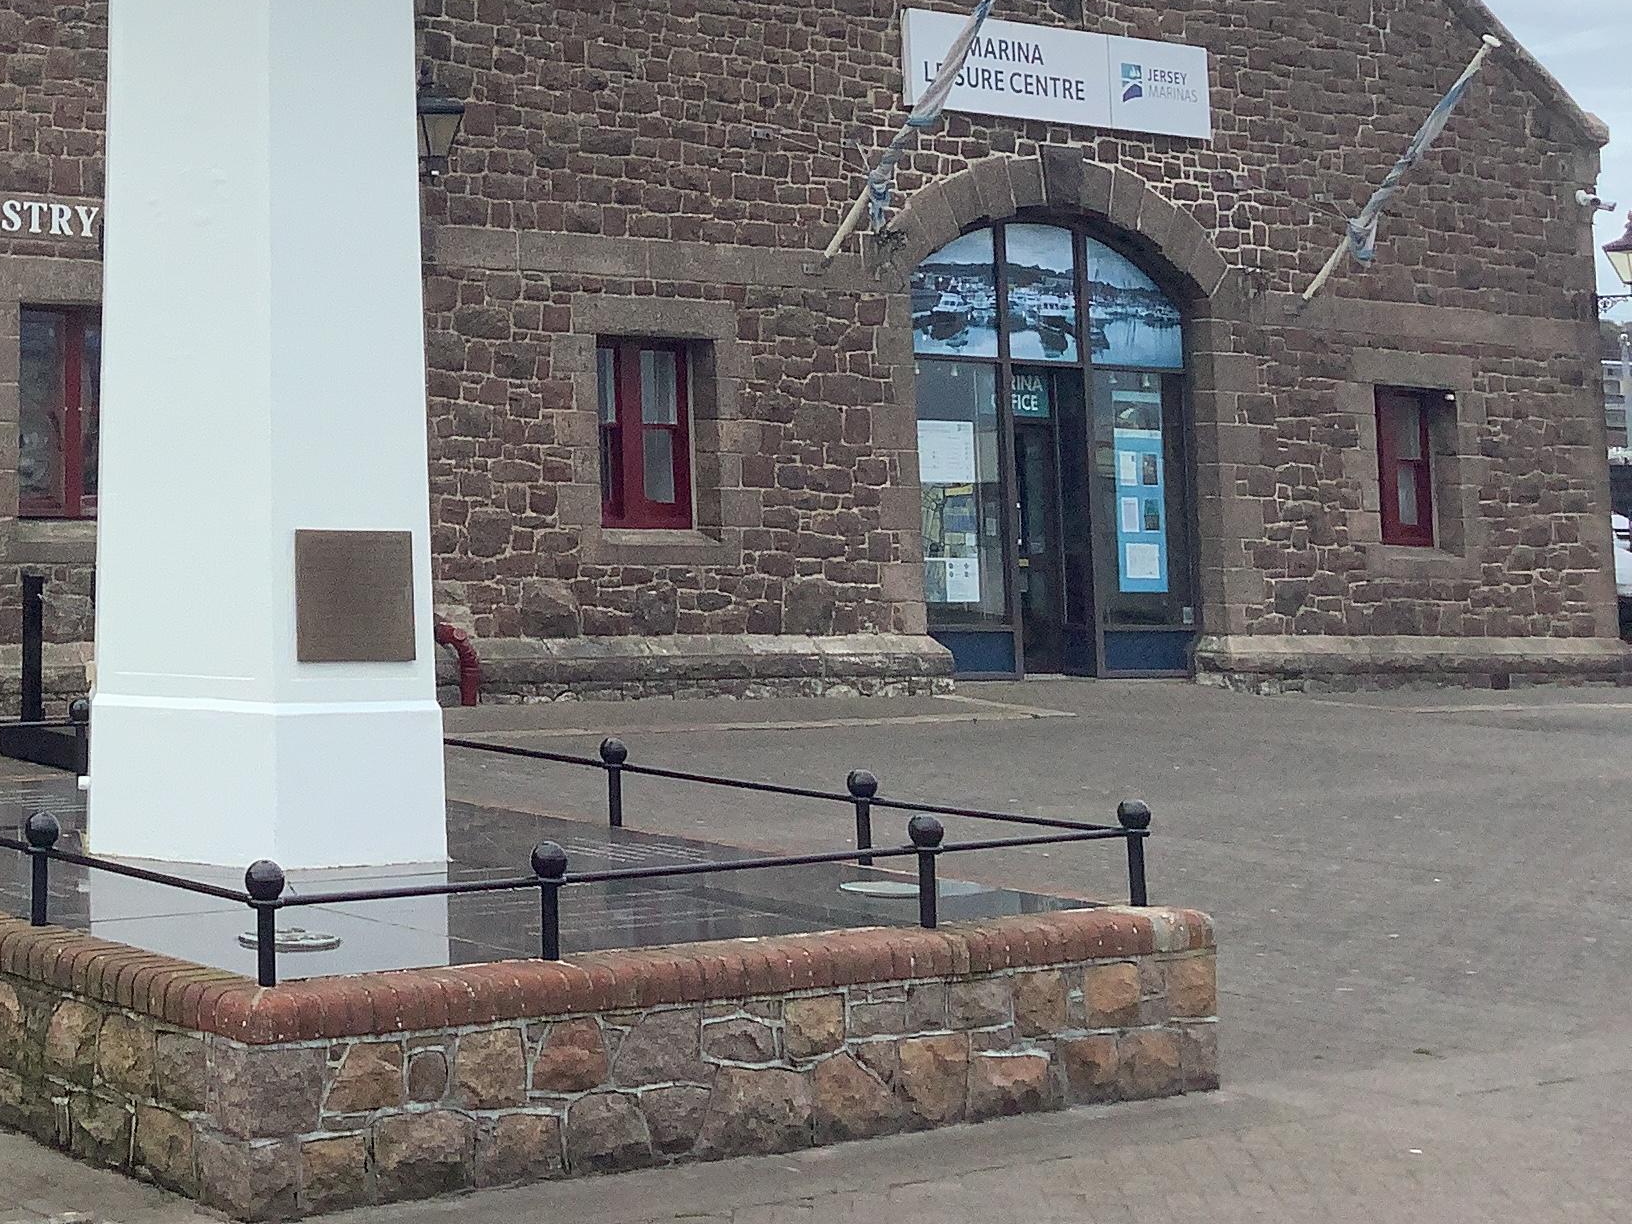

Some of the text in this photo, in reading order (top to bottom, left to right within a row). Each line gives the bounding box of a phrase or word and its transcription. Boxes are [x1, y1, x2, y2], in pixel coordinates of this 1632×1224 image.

[968, 36, 1045, 66] MARINA
[924, 60, 1086, 101] LSURE CENTRE
[1147, 68, 1187, 86] JERSEY
[1147, 84, 1199, 103] MARINAS
